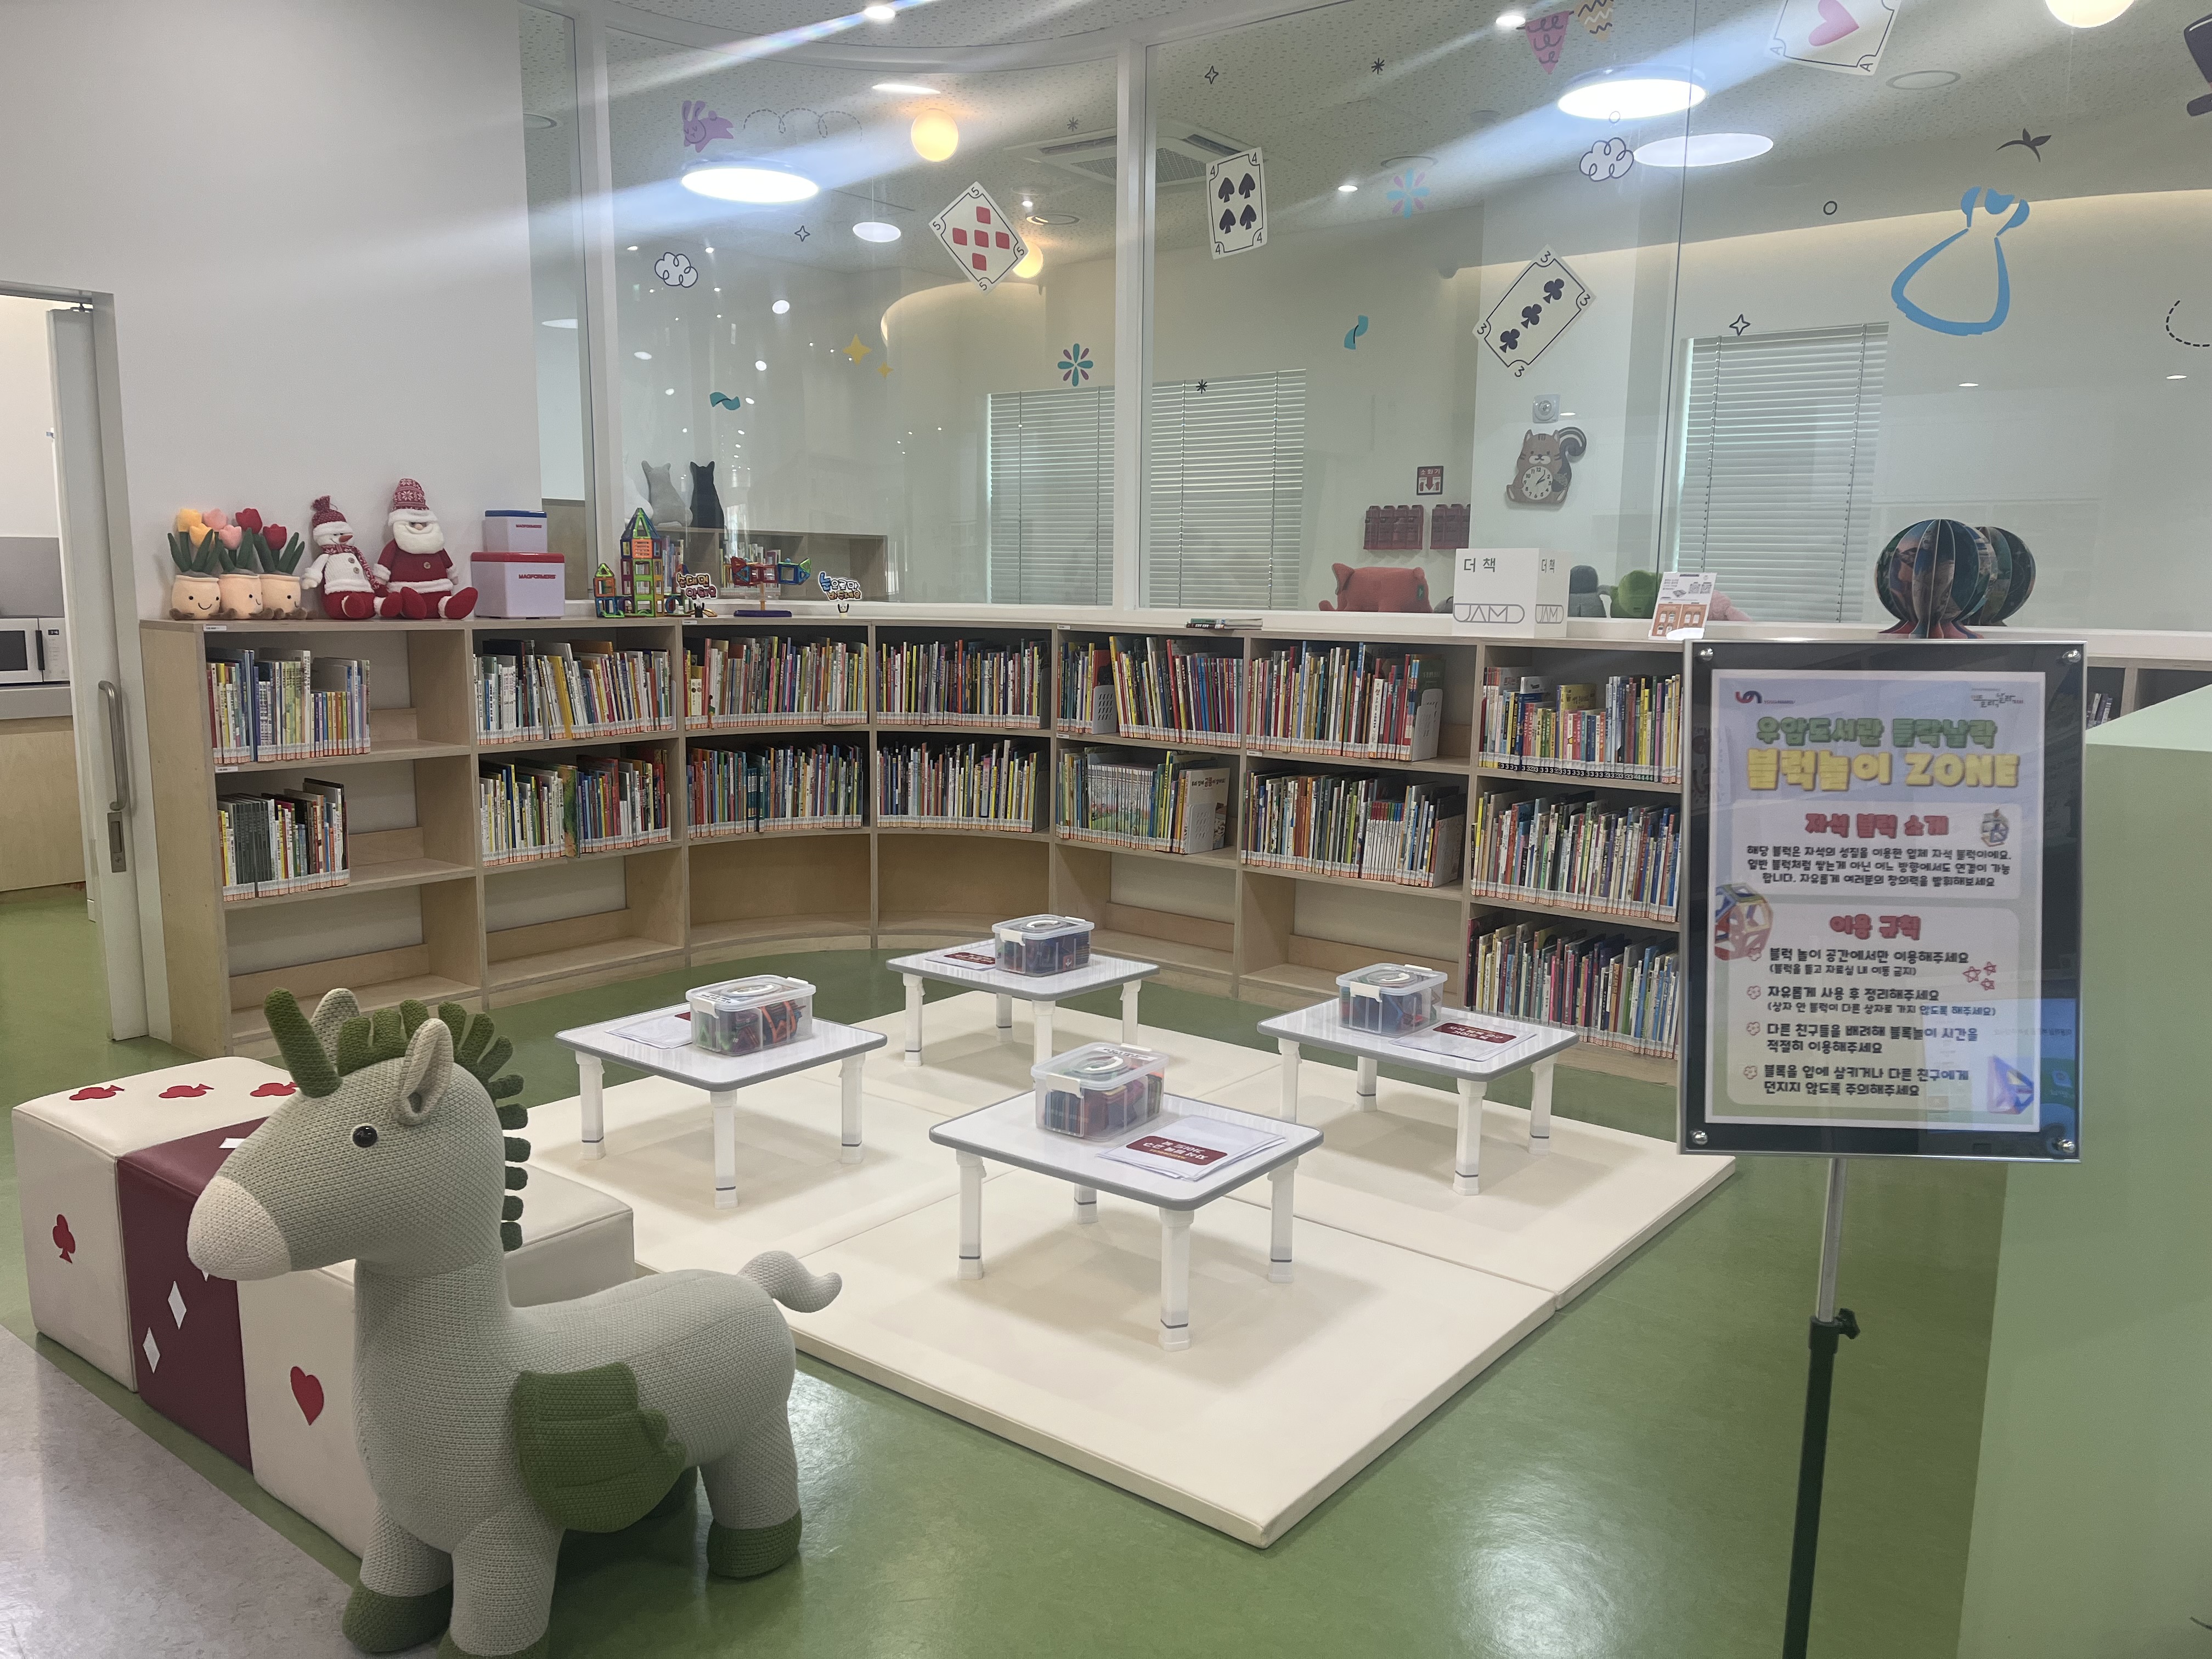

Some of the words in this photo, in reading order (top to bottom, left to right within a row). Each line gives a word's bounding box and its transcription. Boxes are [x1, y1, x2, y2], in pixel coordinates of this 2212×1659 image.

[1859, 63, 1874, 72] A
[1251, 151, 1257, 163] 4
[1210, 165, 1216, 177] 4
[971, 187, 979, 196] 5
[933, 221, 941, 230] 5
[1257, 232, 1262, 244] 4
[1017, 246, 1025, 256] 5
[1215, 243, 1221, 255] 4
[1541, 250, 1551, 263] 3
[979, 281, 988, 291] 5
[1579, 294, 1591, 306] 3
[1477, 323, 1487, 335] 3
[1514, 365, 1525, 377] 3
[1464, 557, 1476, 573] 더
[1483, 557, 1496, 573] 책
[1542, 558, 1547, 573] 더
[1549, 558, 1555, 573] 책
[1757, 716, 1884, 747] 우암도서관
[1747, 748, 1892, 792] 블럭놀이
[1904, 752, 2021, 787] ZONE
[1805, 813, 1850, 838] 자석
[1904, 815, 1949, 836] 소개
[1747, 845, 1768, 857] 해당
[1773, 846, 1801, 857] 블럭은
[1804, 847, 1836, 857] 자석의
[1839, 847, 1868, 858] 성질을
[1872, 848, 1903, 859] 이용한
[1906, 848, 1928, 859] 입체
[1932, 849, 1953, 860] 자석
[1956, 849, 2011, 860] 블럭이에요.
[1747, 859, 1768, 870] 일반
[1772, 859, 1812, 871] 블럭처럼
[1815, 860, 1847, 872] 쌓는게
[1849, 861, 1871, 872] 아닌
[1875, 862, 1894, 872] 어느
[1898, 861, 1951, 873] 방향에서도
[1955, 862, 1987, 874] 연결이
[1990, 864, 2011, 875] 가능
[1762, 872, 1796, 884] 합니다.
[1799, 873, 1840, 885] 자유롭게
[1843, 874, 1884, 886] 여러분의
[1888, 874, 1928, 887] 창의력을
[1932, 876, 1995, 887] 발휘해보세요
[1830, 913, 1873, 940] 이용
[1879, 915, 1921, 941] 규칙
[1770, 947, 1792, 961] 블럭
[1797, 949, 1821, 962] 놀이
[1826, 949, 1889, 963] 공간에서만
[1893, 950, 1969, 964] 이용해주세요
[1769, 963, 1801, 975] (블럭을
[1805, 964, 1822, 975] 들고
[1825, 965, 1854, 976] 자료실
[1857, 966, 1868, 974] 내
[1871, 966, 1890, 977] 이동
[1894, 966, 1916, 977] 금지)
[1768, 986, 1816, 1000] 자유롭게
[1821, 987, 1844, 1001] 사용
[1849, 988, 1859, 1000] 후
[1864, 988, 1939, 1001] 정리해주세요
[1768, 1002, 1792, 1013] (상자
[1796, 1002, 1806, 1013] 안
[1810, 1003, 1838, 1013] 블럭이
[1842, 1003, 1860, 1014] 다른
[1864, 1004, 1892, 1014] 상자로
[1896, 1005, 1916, 1013] 가지
[1920, 1005, 1948, 1015] 않도록
[1951, 1006, 1996, 1016] 해주세요)
[1767, 1023, 1791, 1036] 다른
[1796, 1023, 1841, 1037] 친구들을
[1846, 1025, 1886, 1036] 배려해
[1890, 1026, 1937, 1040] 블록놀이
[1941, 1028, 1978, 1041] 시간을
[1767, 1040, 1804, 1053] 적절히
[1808, 1040, 1882, 1054] 이용해주세요
[1764, 1064, 1797, 1078] 블록을
[1802, 1065, 1829, 1079] 입에
[1834, 1066, 1883, 1079] 삼키거나
[1888, 1068, 1912, 1081] 다른
[1917, 1068, 1969, 1082] 친구에게
[1764, 1081, 1801, 1094] 던지지
[1805, 1082, 1841, 1096] 않도록
[1846, 1083, 1919, 1096] 주의해주세요
